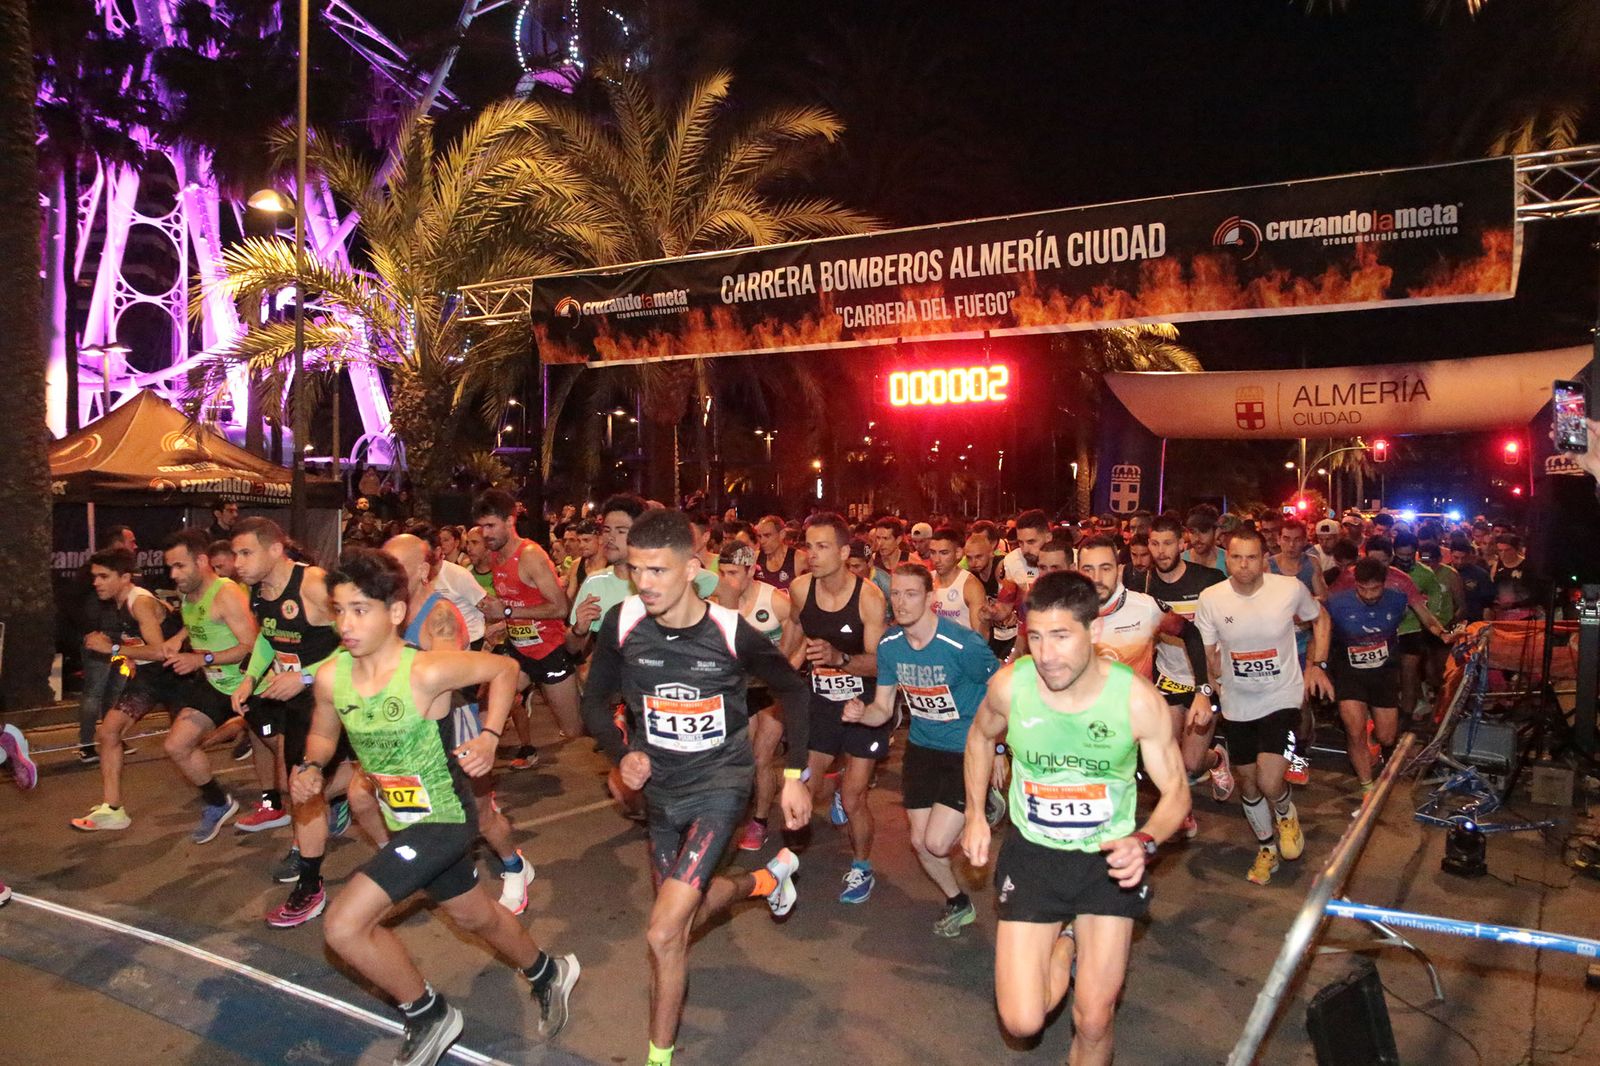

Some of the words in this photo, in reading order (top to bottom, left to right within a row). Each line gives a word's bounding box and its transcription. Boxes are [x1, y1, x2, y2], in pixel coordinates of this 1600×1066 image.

[1265, 203, 1458, 242] cruzandolameta
[1322, 231, 1399, 247] cronometraje
[1400, 225, 1459, 240] deportivo
[720, 263, 816, 305] CARRERA
[820, 249, 944, 293] BOMBEROS
[950, 229, 1061, 280] ALMERÍA
[1067, 222, 1166, 267] CIUDAD
[582, 288, 688, 316] cruzandolameta
[921, 297, 952, 321] DEL
[1293, 375, 1431, 408] ALMERÍA
[1293, 410, 1362, 426] CIUDAD
[1360, 649, 1383, 661] 281
[1243, 659, 1275, 673] 295
[825, 676, 856, 689] 155
[917, 696, 947, 709] 183
[666, 714, 715, 734] 132
[1026, 750, 1111, 772] Universo
[1050, 802, 1092, 816] 513
